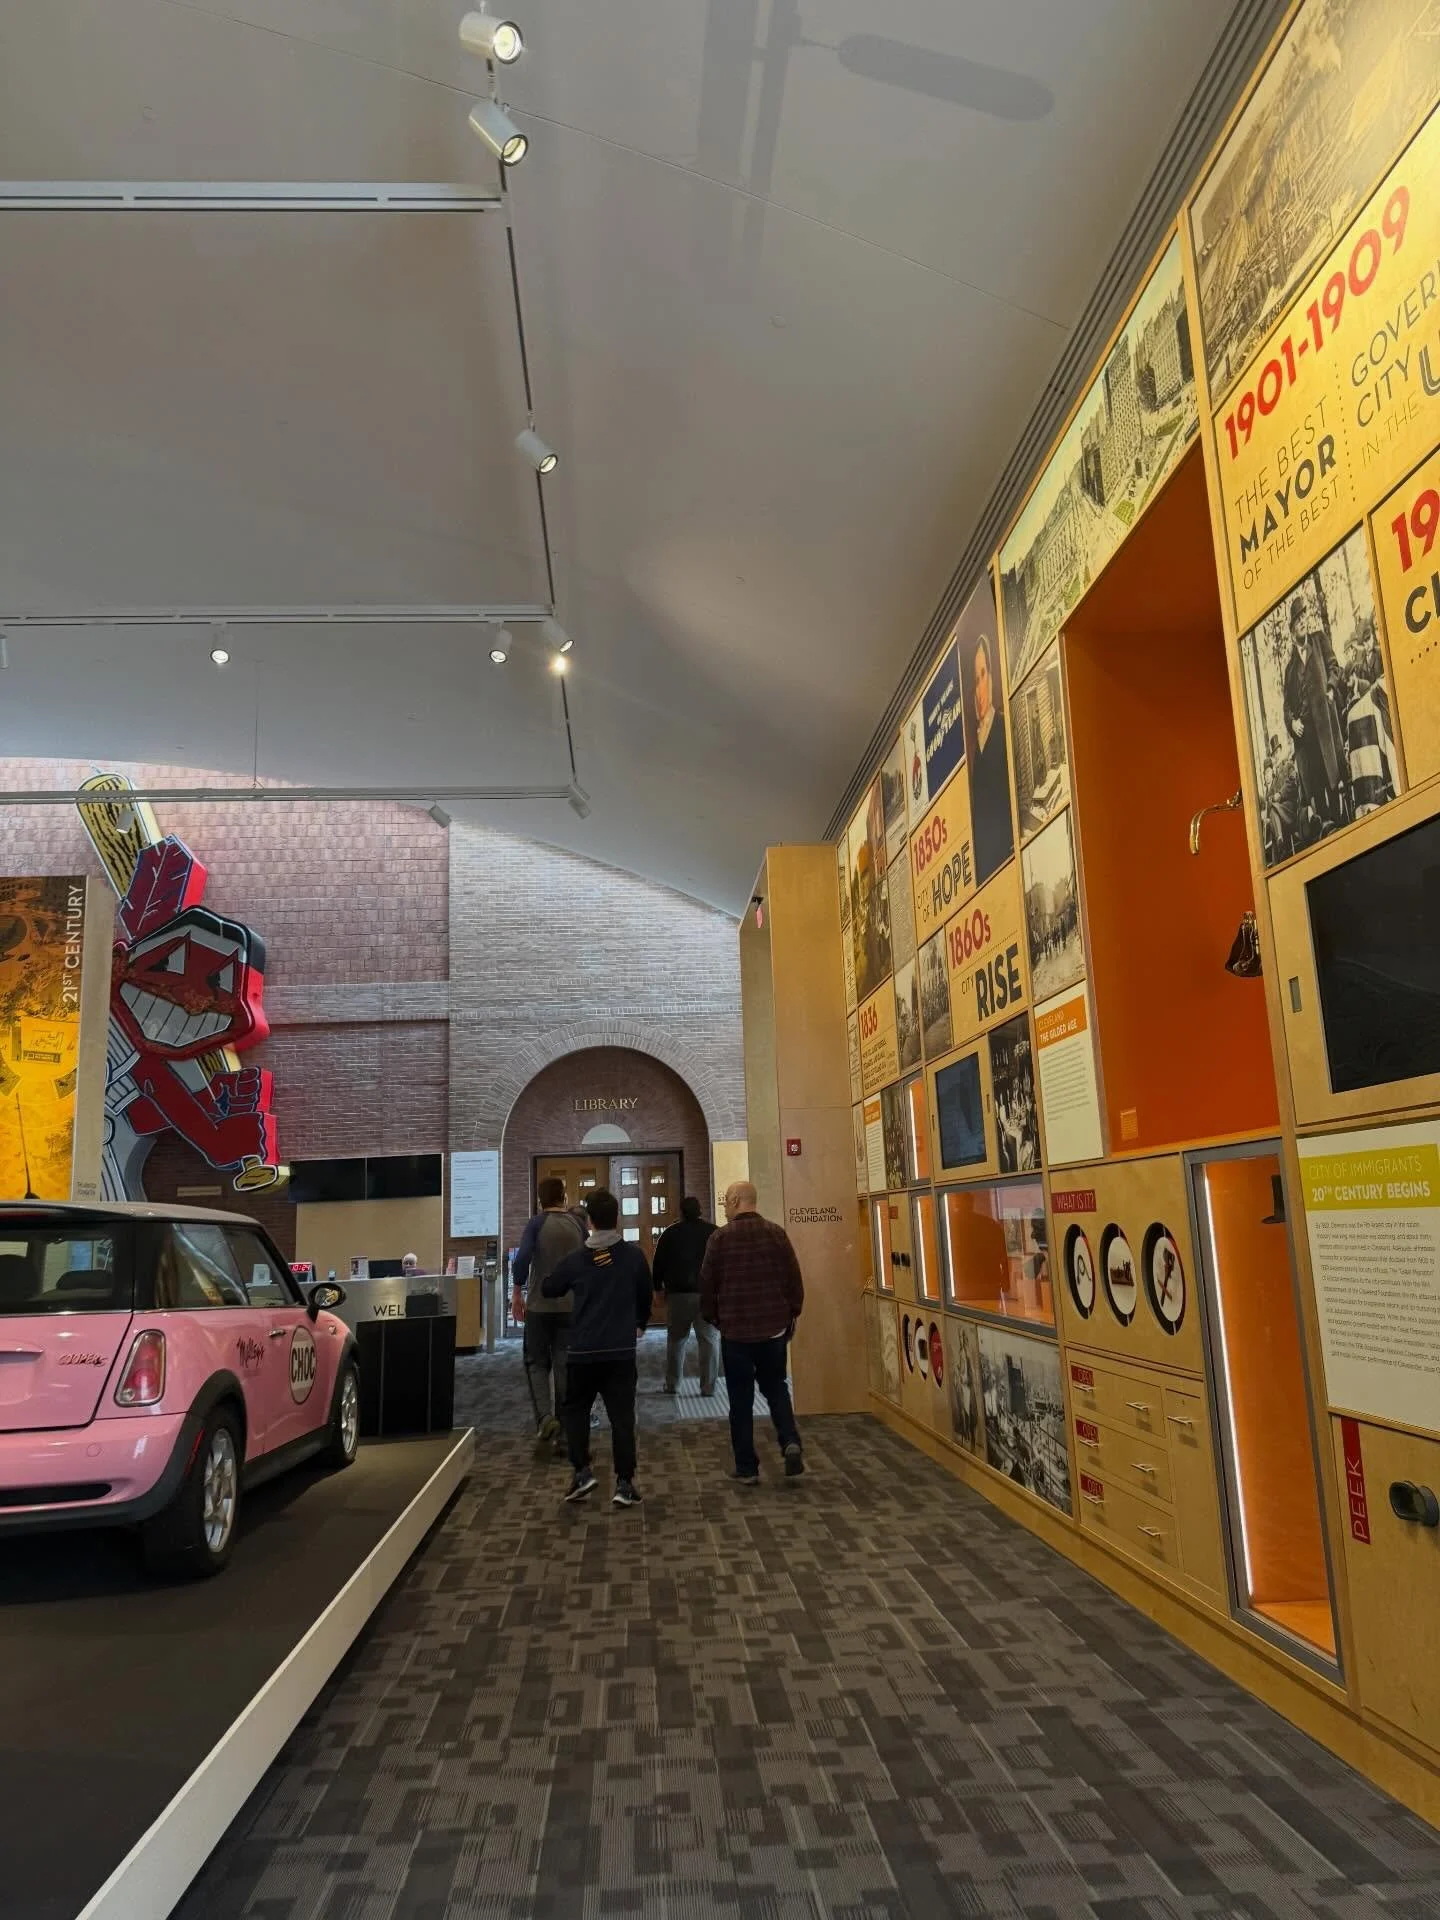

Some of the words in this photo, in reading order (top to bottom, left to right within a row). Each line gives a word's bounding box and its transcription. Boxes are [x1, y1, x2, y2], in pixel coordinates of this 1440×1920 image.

[1225, 185, 1410, 461] 1901-1909
[1351, 260, 1440, 387] GOVER
[1357, 344, 1411, 427] CITY
[1235, 467, 1271, 523] THE
[1277, 395, 1327, 478] BEST
[1361, 435, 1380, 466] IN
[1384, 391, 1422, 441] THE
[1240, 434, 1336, 565] MAYOR
[1243, 558, 1262, 589] OF
[1266, 523, 1296, 564] THE
[1300, 475, 1339, 533] BEST
[1391, 489, 1440, 573] 19
[1404, 571, 1440, 633] CI
[932, 840, 971, 916] HOPE
[64, 884, 84, 969] CENTURY
[962, 975, 974, 994] CITY
[975, 942, 1022, 1022] RISE
[861, 1001, 878, 1040] 1836
[574, 1097, 638, 1111] LIBRARY
[1056, 1194, 1075, 1208] WHAT
[1309, 1165, 1331, 1180] CITY
[1334, 1163, 1346, 1178] OF
[1351, 1155, 1422, 1176] IMMIGRANTS
[1312, 1186, 1332, 1202] 20TH
[1335, 1184, 1383, 1200] CENTURY
[1387, 1181, 1431, 1199] BEGINS
[790, 1206, 836, 1215] CLEVELAND
[790, 1215, 842, 1223] FOUNDATION
[291, 1346, 316, 1383] CHOC
[1347, 1457, 1368, 1539] PEEK
